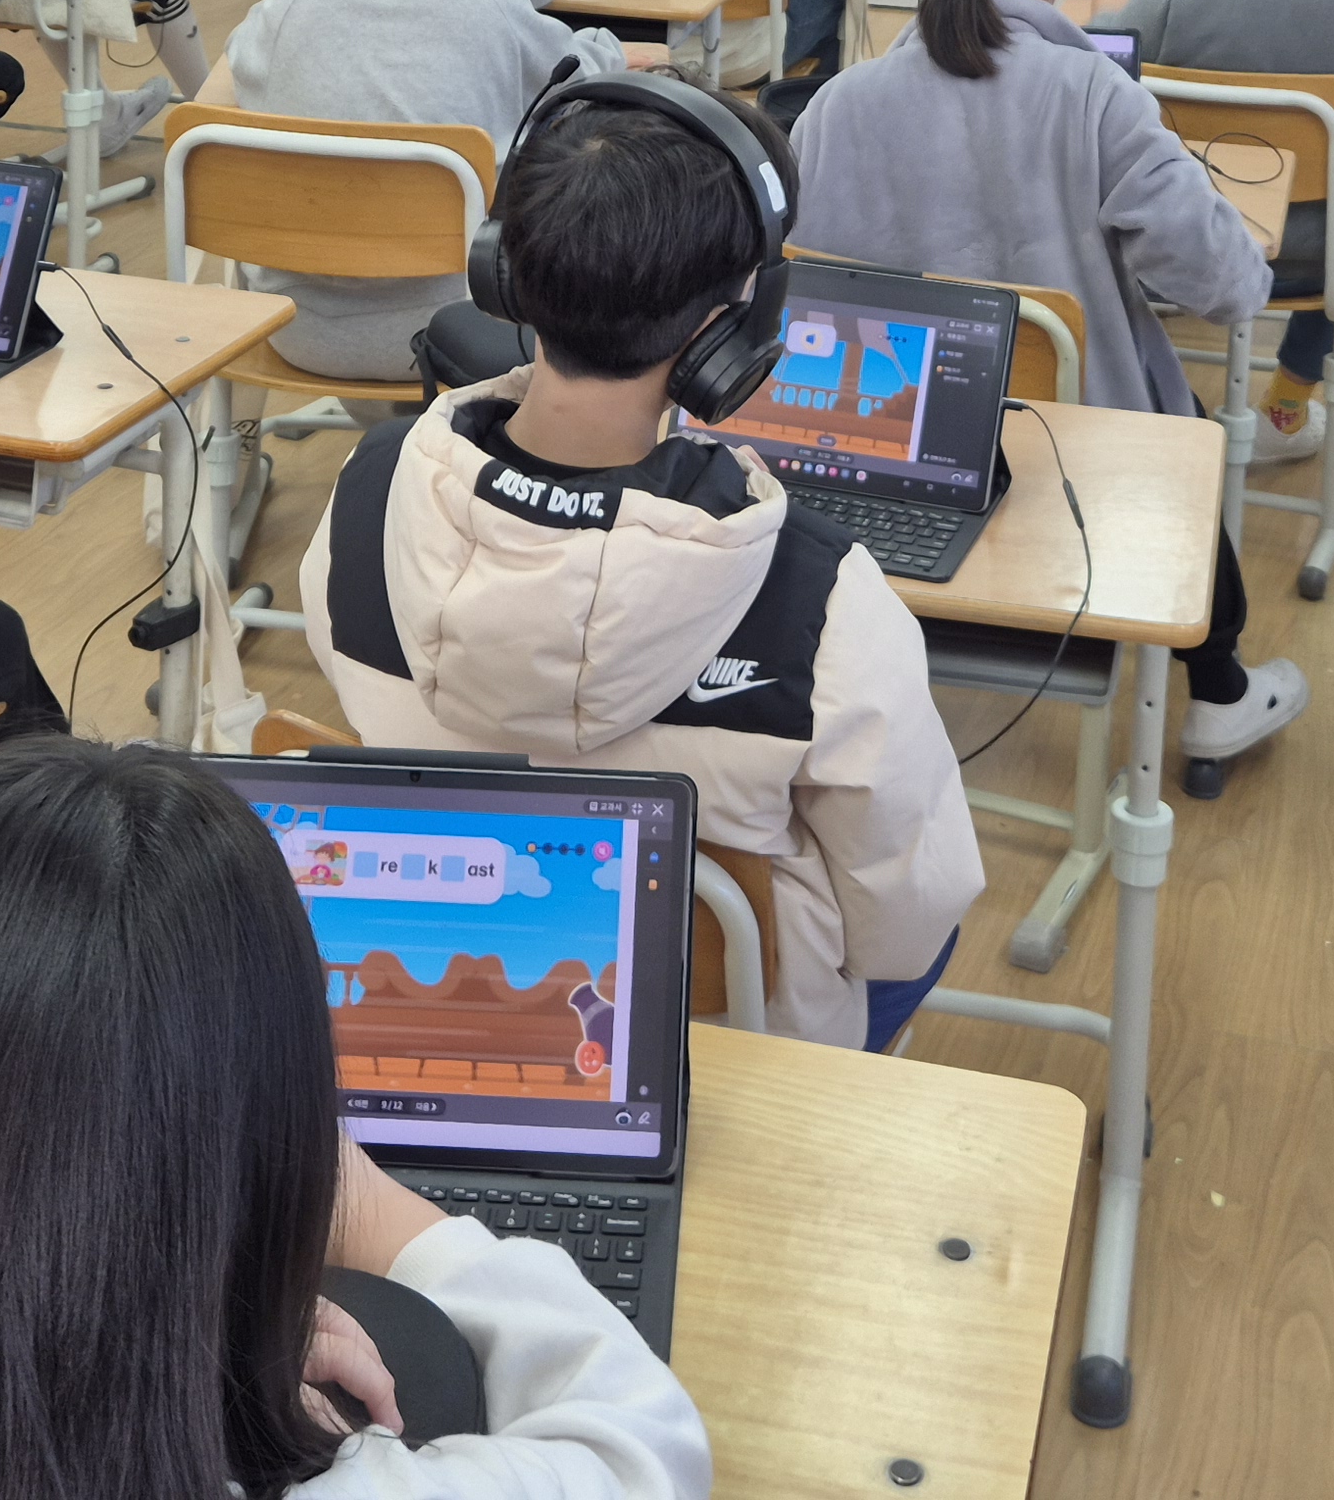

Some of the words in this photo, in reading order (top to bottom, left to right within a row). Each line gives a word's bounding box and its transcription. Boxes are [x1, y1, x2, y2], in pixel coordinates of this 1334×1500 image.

[492, 467, 548, 507] JUST
[547, 489, 578, 517] DO
[699, 656, 760, 685] NIKE
[600, 802, 623, 813] 교과서
[380, 860, 398, 875] re
[428, 860, 439, 875] k
[467, 862, 496, 878] ast
[380, 1100, 403, 1111] 9/12
